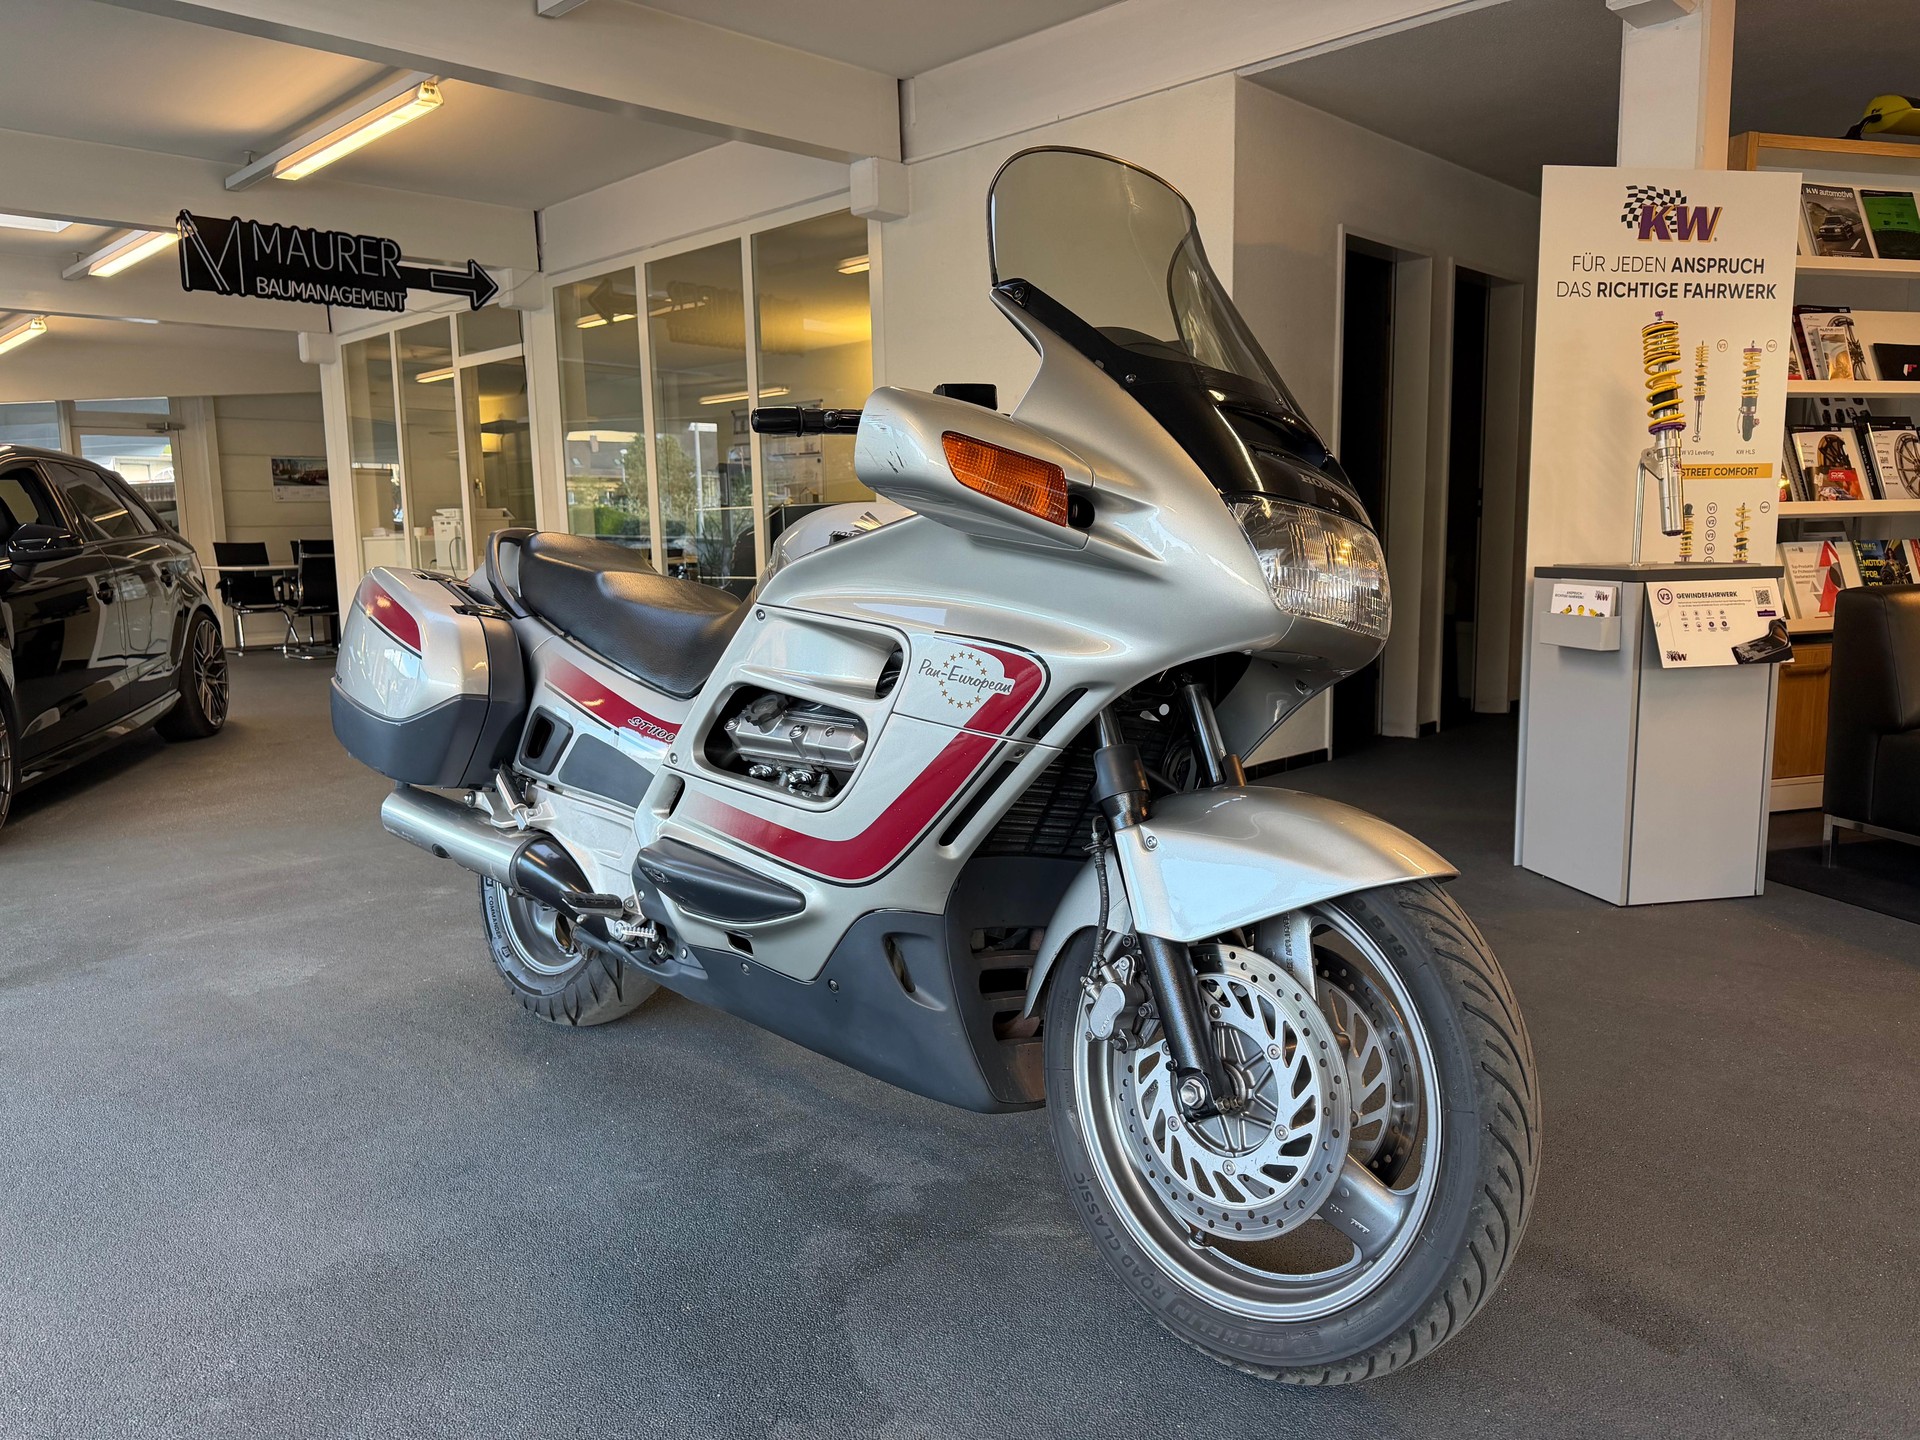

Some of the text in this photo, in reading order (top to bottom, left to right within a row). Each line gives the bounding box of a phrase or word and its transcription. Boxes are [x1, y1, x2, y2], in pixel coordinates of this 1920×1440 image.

[1805, 187, 1818, 195] KW
[1819, 188, 1854, 199] automotive
[1637, 204, 1723, 242] KW
[252, 222, 401, 279] MAURER
[1571, 252, 1765, 275] FÜR JEDEN ANSPRUCH
[256, 276, 406, 310] BAUMANAGEMENT
[1556, 281, 1777, 300] DAS RICHTIGE FAHRWERK
[1694, 449, 1715, 457] Leveling
[1681, 467, 1712, 477] STREET
[1713, 466, 1759, 476] COMFORT
[1863, 559, 1886, 567] MOTION
[1865, 570, 1878, 578] FOR
[1676, 591, 1738, 600] GEWINDEFAHRWERK
[1669, 652, 1688, 662] KW
[918, 658, 1012, 693] Pan-European
[627, 716, 676, 742] ST1100
[488, 895, 503, 940] COMMANDER
[1073, 1172, 1285, 1352] MICHELIN ROAD CLASSIC
